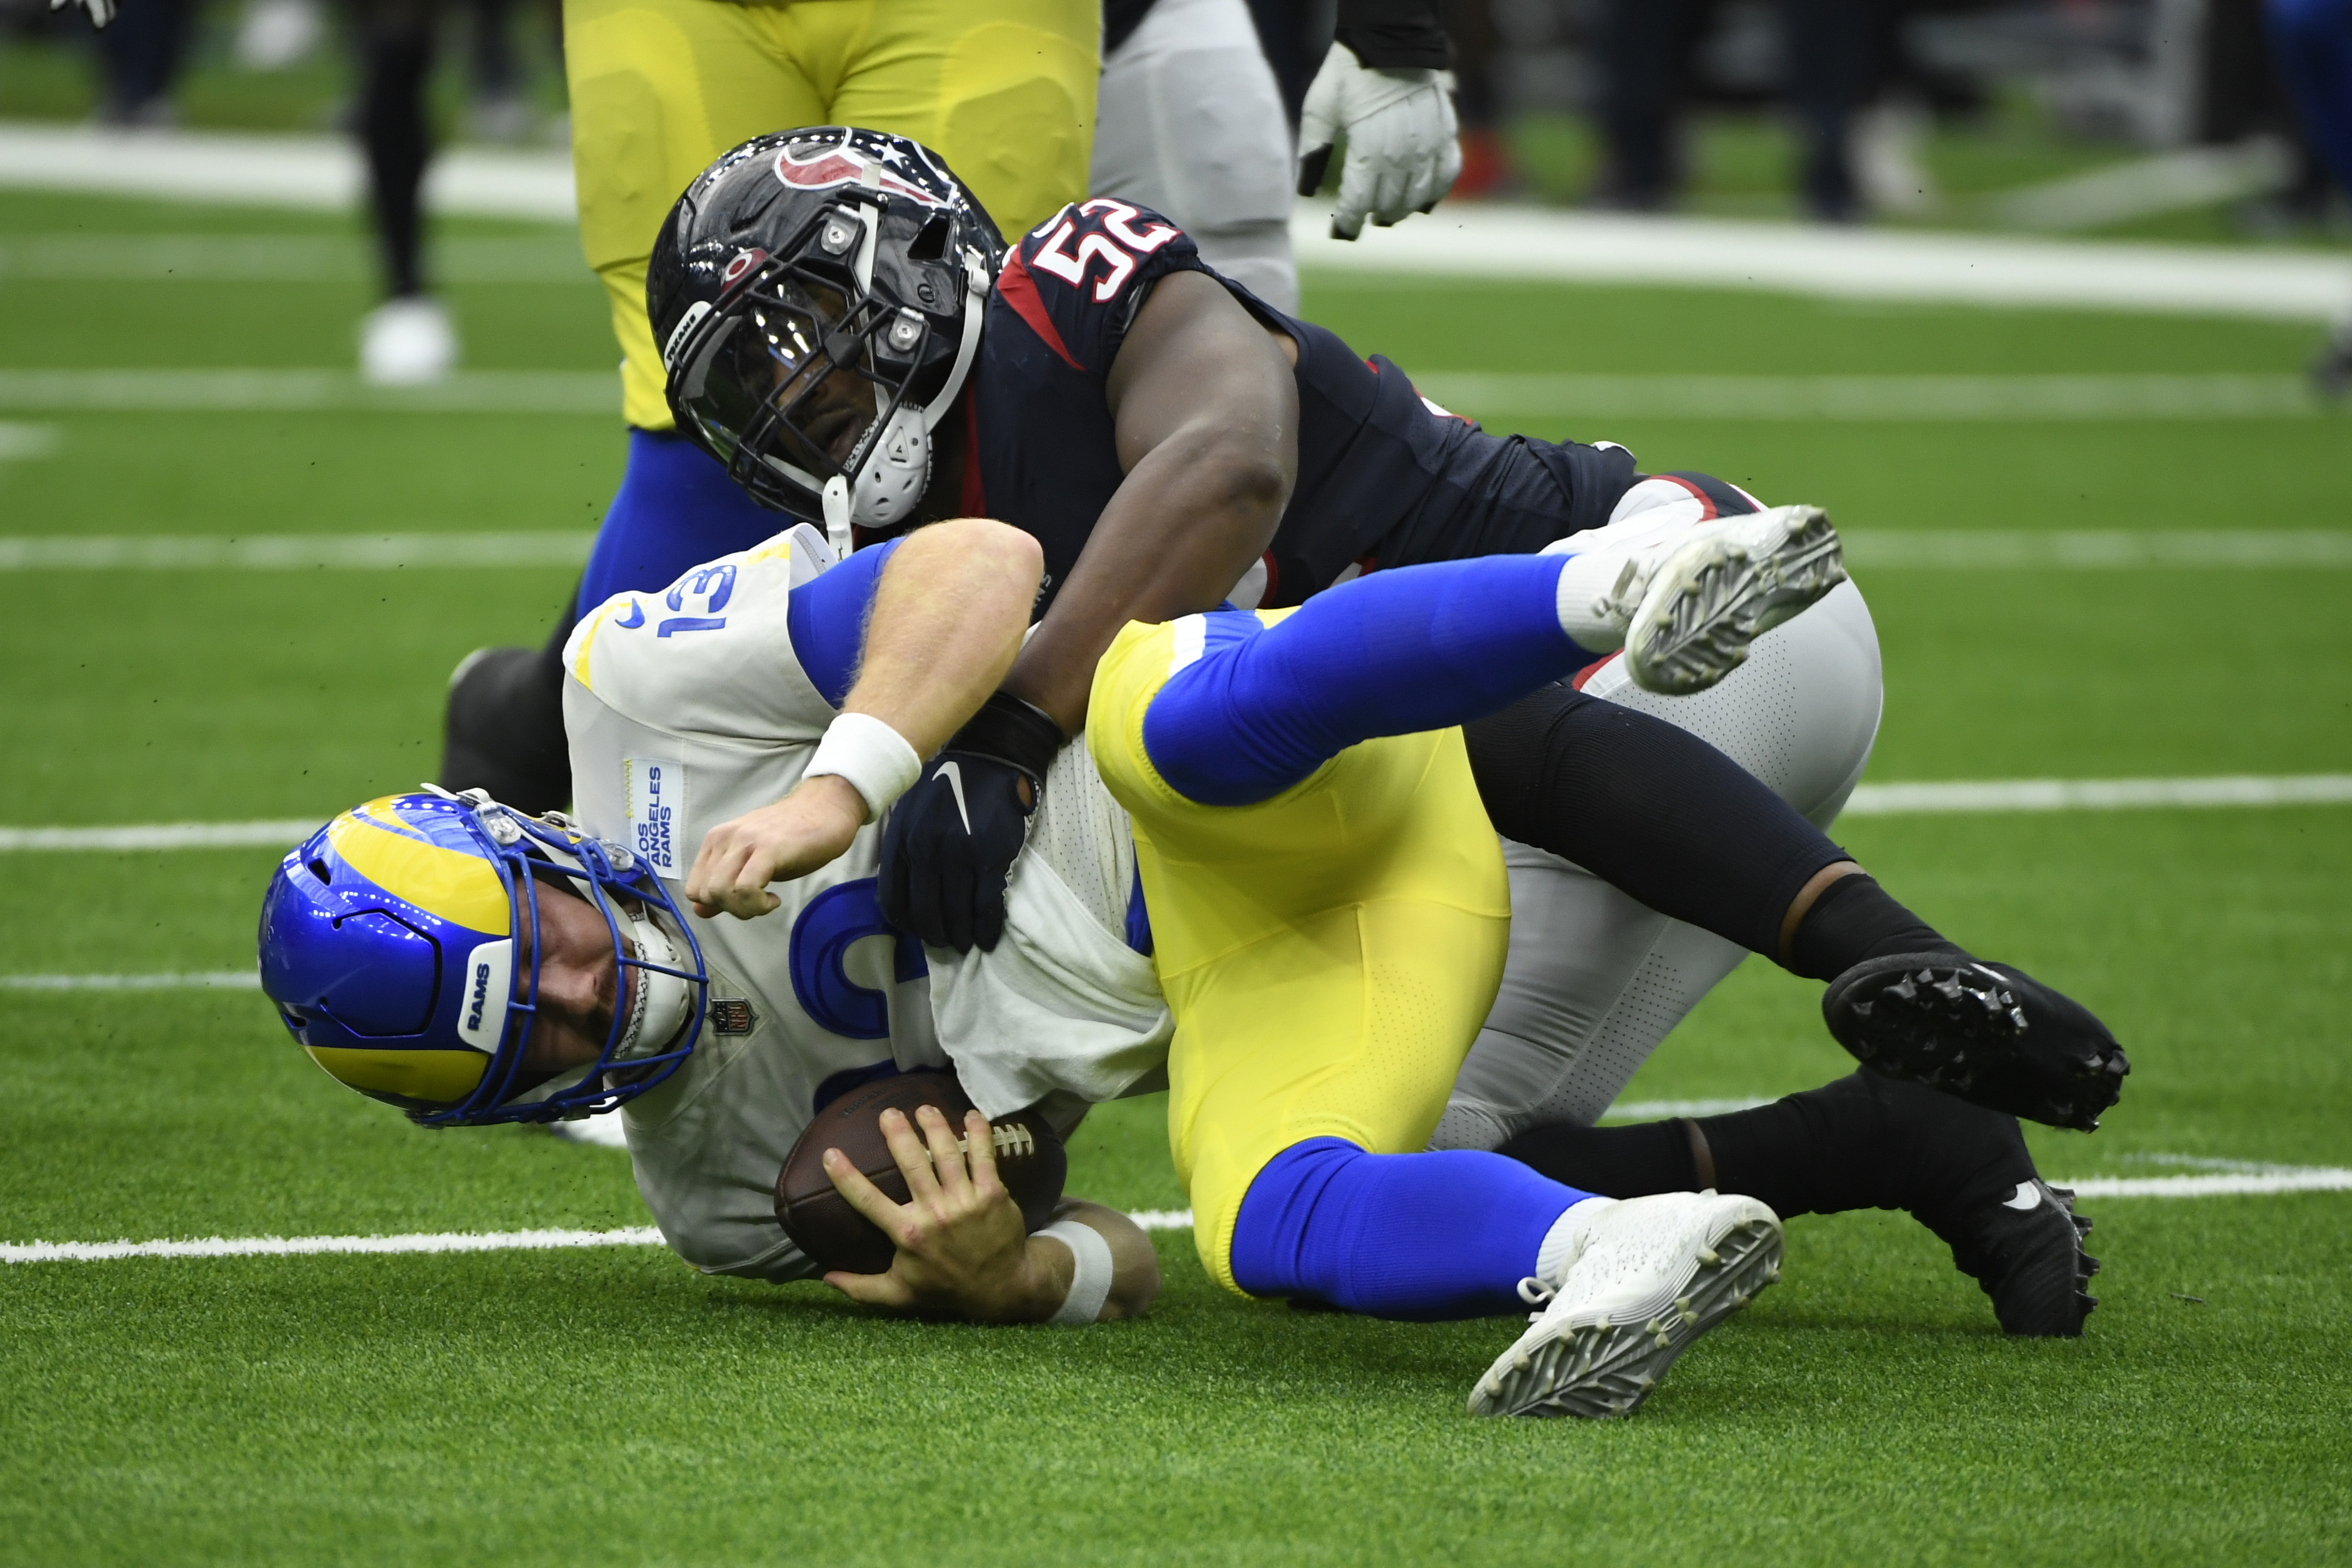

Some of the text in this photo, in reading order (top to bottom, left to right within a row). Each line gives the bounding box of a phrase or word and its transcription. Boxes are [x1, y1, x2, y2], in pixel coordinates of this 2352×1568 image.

[1029, 197, 1183, 303] 52
[666, 313, 696, 361] TEXANS
[657, 564, 737, 638] 13
[648, 766, 661, 866] ANGELES
[660, 806, 672, 868] RAMS
[467, 963, 490, 1031] RAMS
